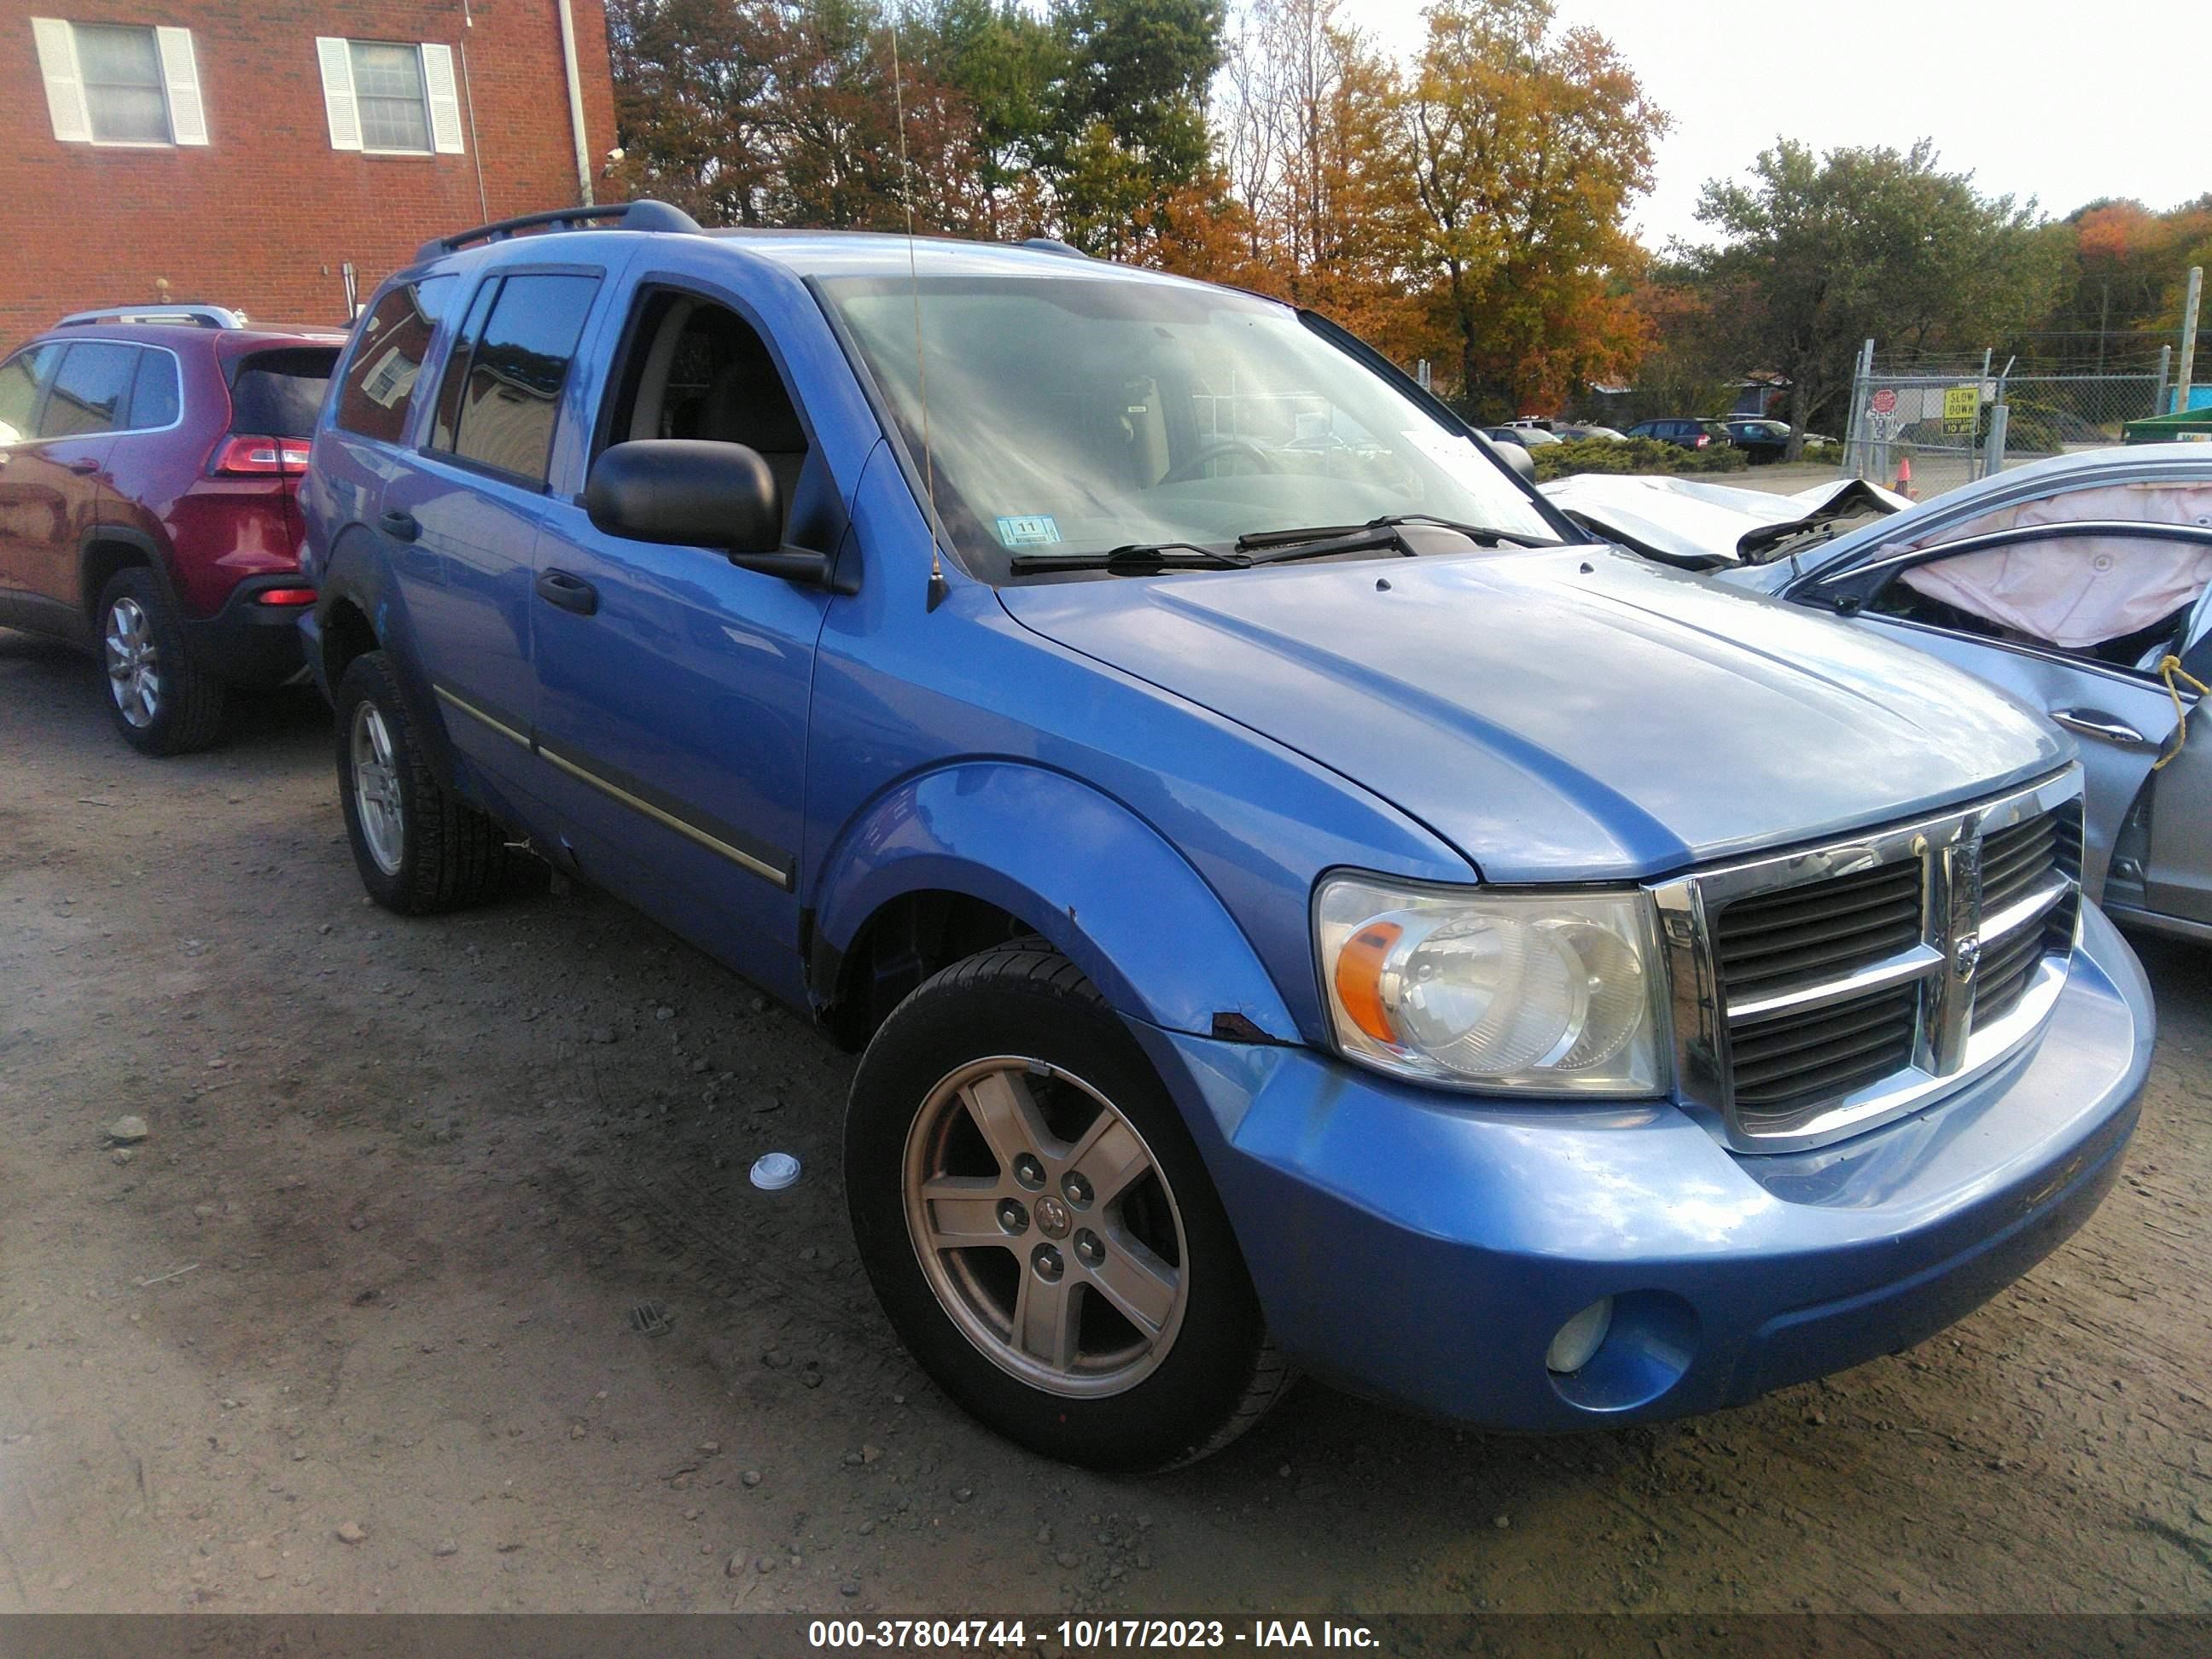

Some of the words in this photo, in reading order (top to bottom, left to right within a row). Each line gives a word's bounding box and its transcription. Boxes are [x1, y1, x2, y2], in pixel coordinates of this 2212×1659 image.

[1951, 393, 1973, 403] SLOW
[1950, 405, 1973, 415] DOWN
[1018, 522, 1035, 532] 11
